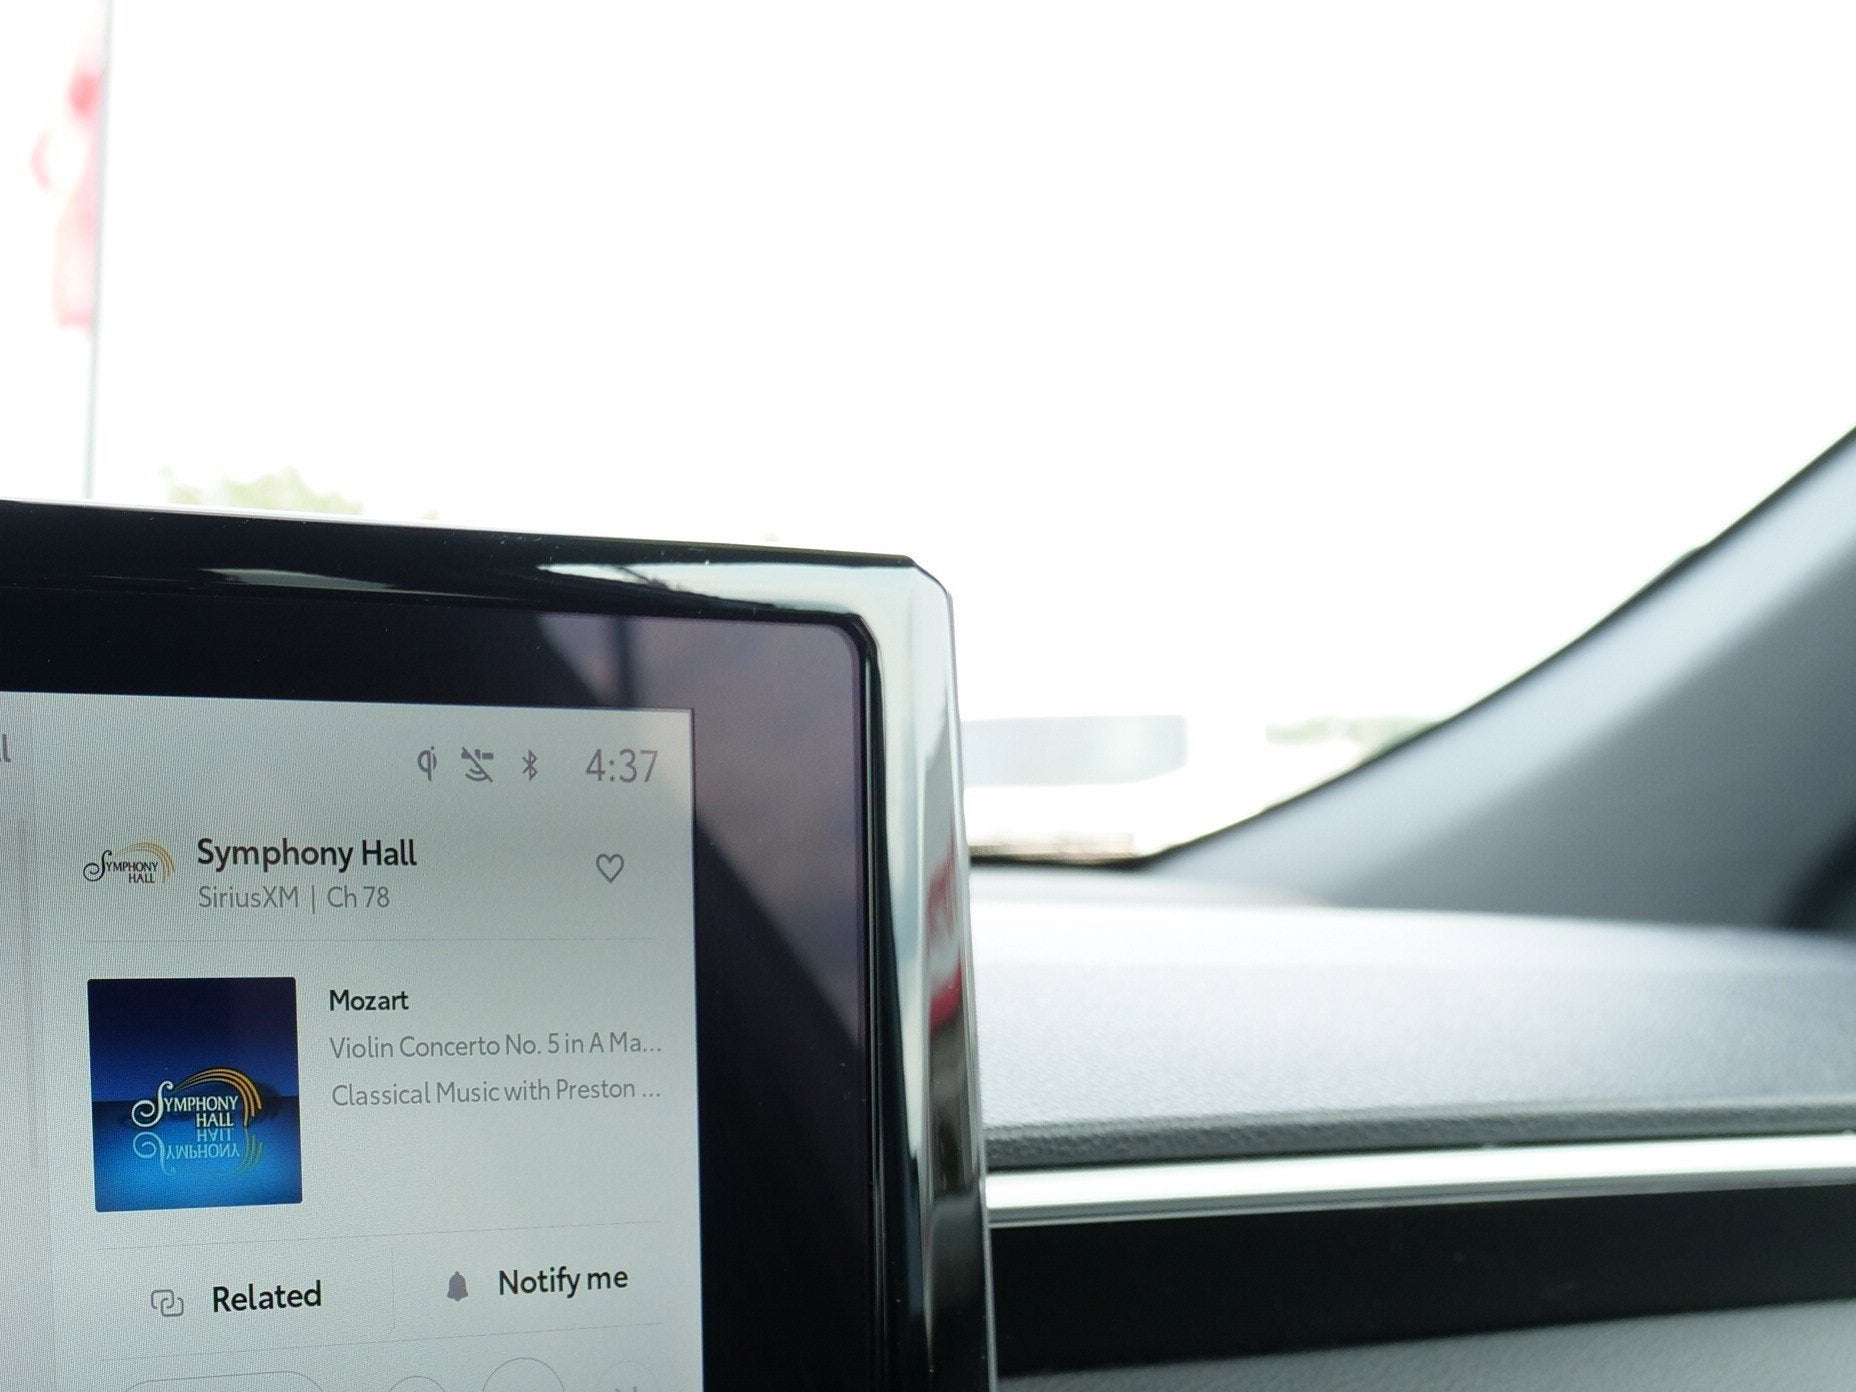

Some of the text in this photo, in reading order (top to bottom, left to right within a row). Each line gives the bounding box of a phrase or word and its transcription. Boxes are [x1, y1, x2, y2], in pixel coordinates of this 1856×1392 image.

[586, 749, 658, 783] 4:37
[197, 837, 418, 873] Symphony Hall
[128, 873, 155, 883] HALL
[198, 885, 300, 910] SiriusXM
[326, 885, 360, 910] Ch
[363, 885, 391, 909] 78
[329, 989, 410, 1012] Mozart
[330, 1036, 395, 1060] Violin
[399, 1034, 501, 1058] Concerto
[505, 1034, 542, 1057] No.
[547, 1034, 560, 1055] 5
[564, 1033, 585, 1055] in
[588, 1032, 605, 1054] A
[132, 1080, 239, 1127] SYMPHONY
[331, 1082, 432, 1107] Classical
[435, 1080, 501, 1105] Music
[503, 1080, 552, 1102] with
[556, 1077, 635, 1101] Preston
[196, 1113, 235, 1128] HALL
[212, 1279, 323, 1314] Related
[498, 1265, 629, 1299] Notify me
